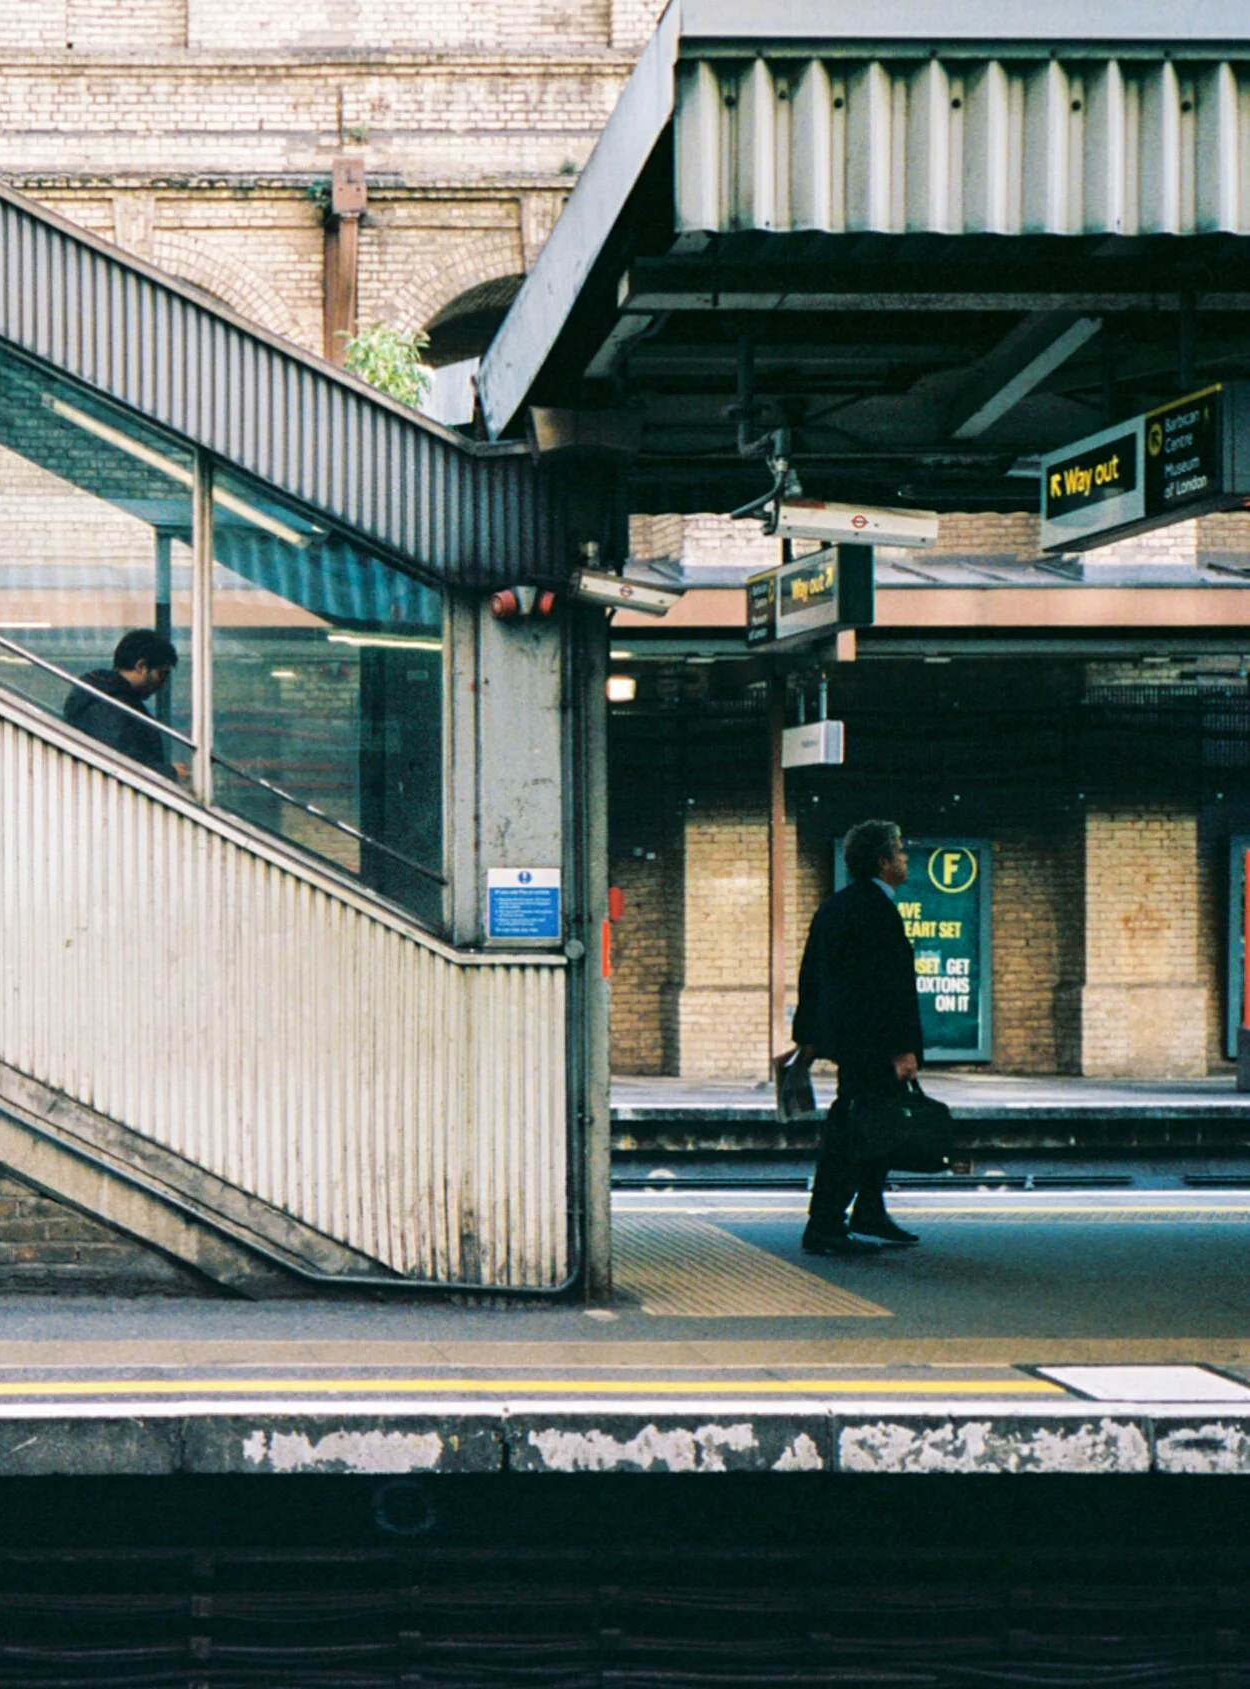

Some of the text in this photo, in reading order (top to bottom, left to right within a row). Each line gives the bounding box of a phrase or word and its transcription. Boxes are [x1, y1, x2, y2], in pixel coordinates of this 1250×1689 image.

[1164, 433, 1194, 454] Centre
[1063, 454, 1120, 497] Way out
[1164, 457, 1200, 477] Museum
[1164, 474, 1208, 499] of London
[791, 578, 810, 602] Way
[810, 573, 825, 595] out
[943, 853, 961, 886] F
[897, 902, 922, 919] AVE
[904, 921, 962, 938] EART SET
[914, 957, 970, 975] SET GET
[916, 976, 970, 993] OXTONS
[935, 995, 970, 1012] ON IT
